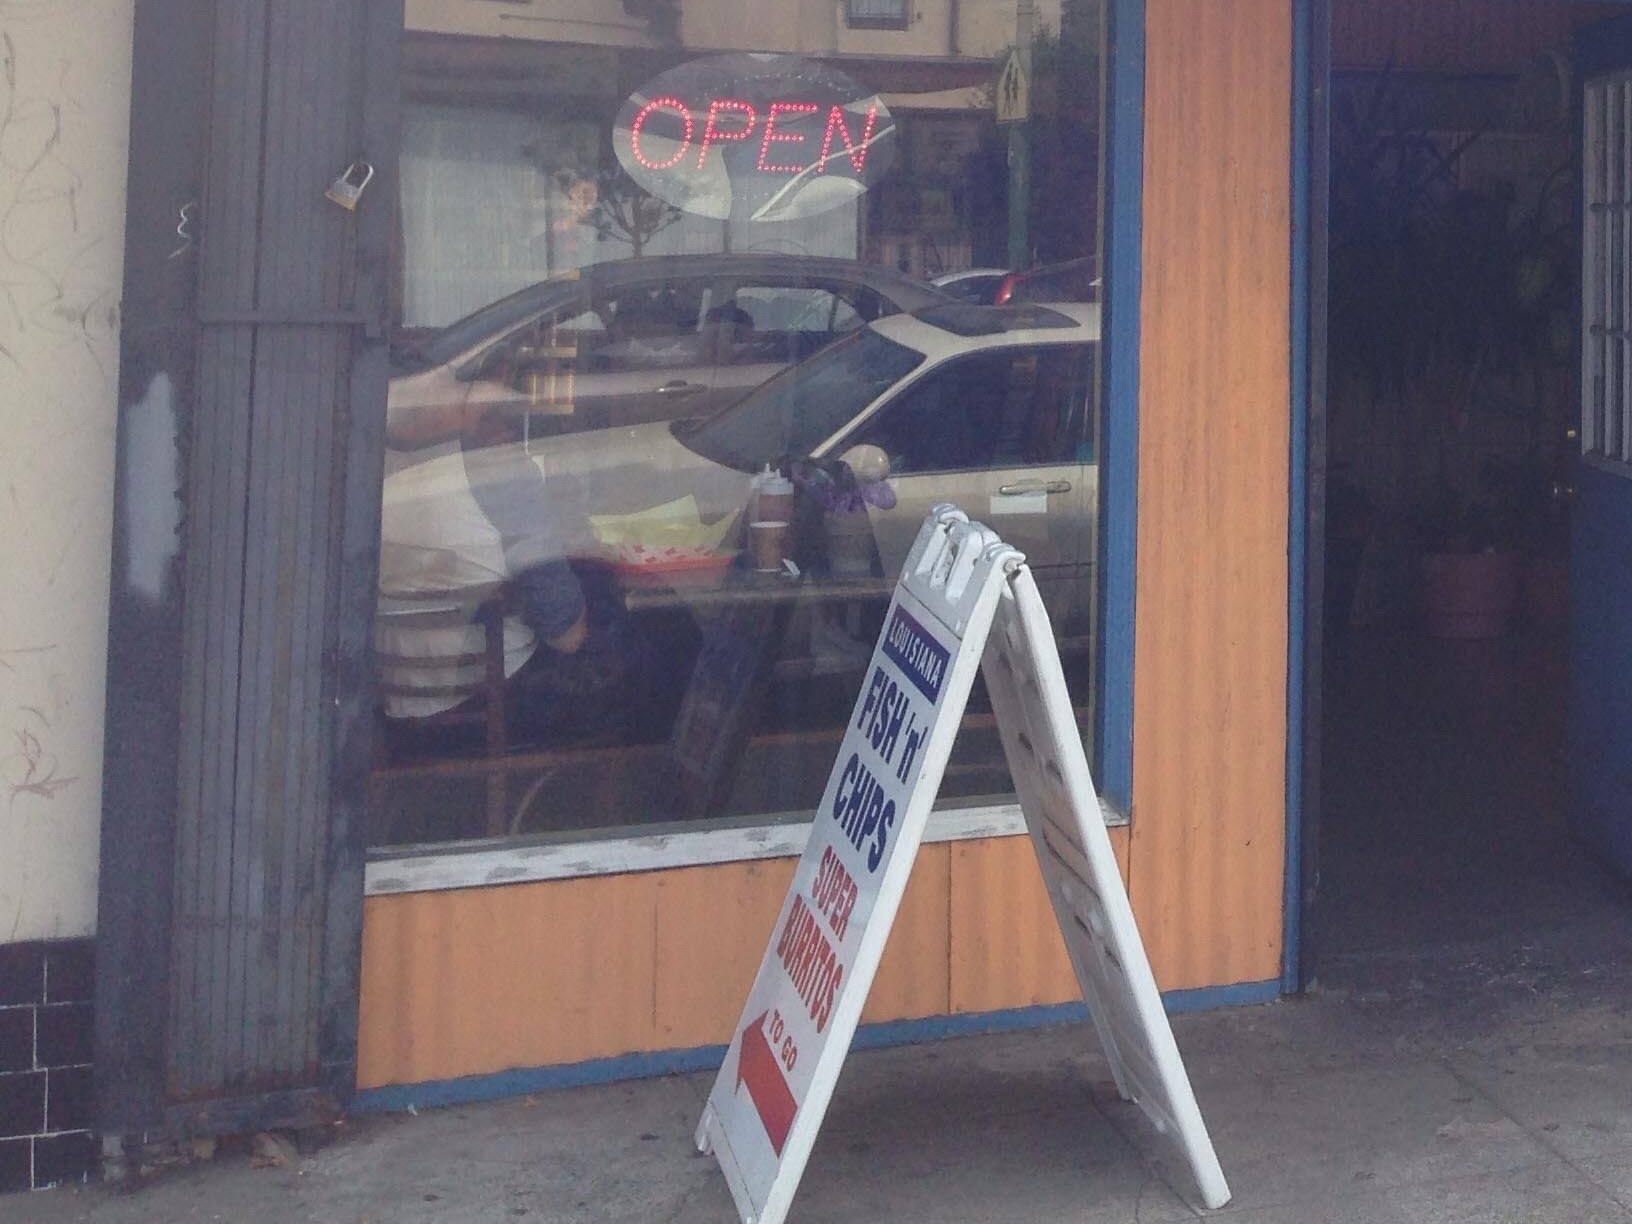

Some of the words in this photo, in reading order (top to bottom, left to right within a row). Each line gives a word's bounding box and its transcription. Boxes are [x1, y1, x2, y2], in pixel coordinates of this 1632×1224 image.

[631, 97, 878, 173] OPEN
[889, 617, 943, 689] LOUISIANA
[857, 666, 909, 764] FISH
[833, 752, 895, 874] CHIPS
[812, 845, 858, 942] SUPER
[777, 893, 843, 1034] BURRITOS
[769, 1009, 784, 1044] TO
[781, 1036, 798, 1071] GO
